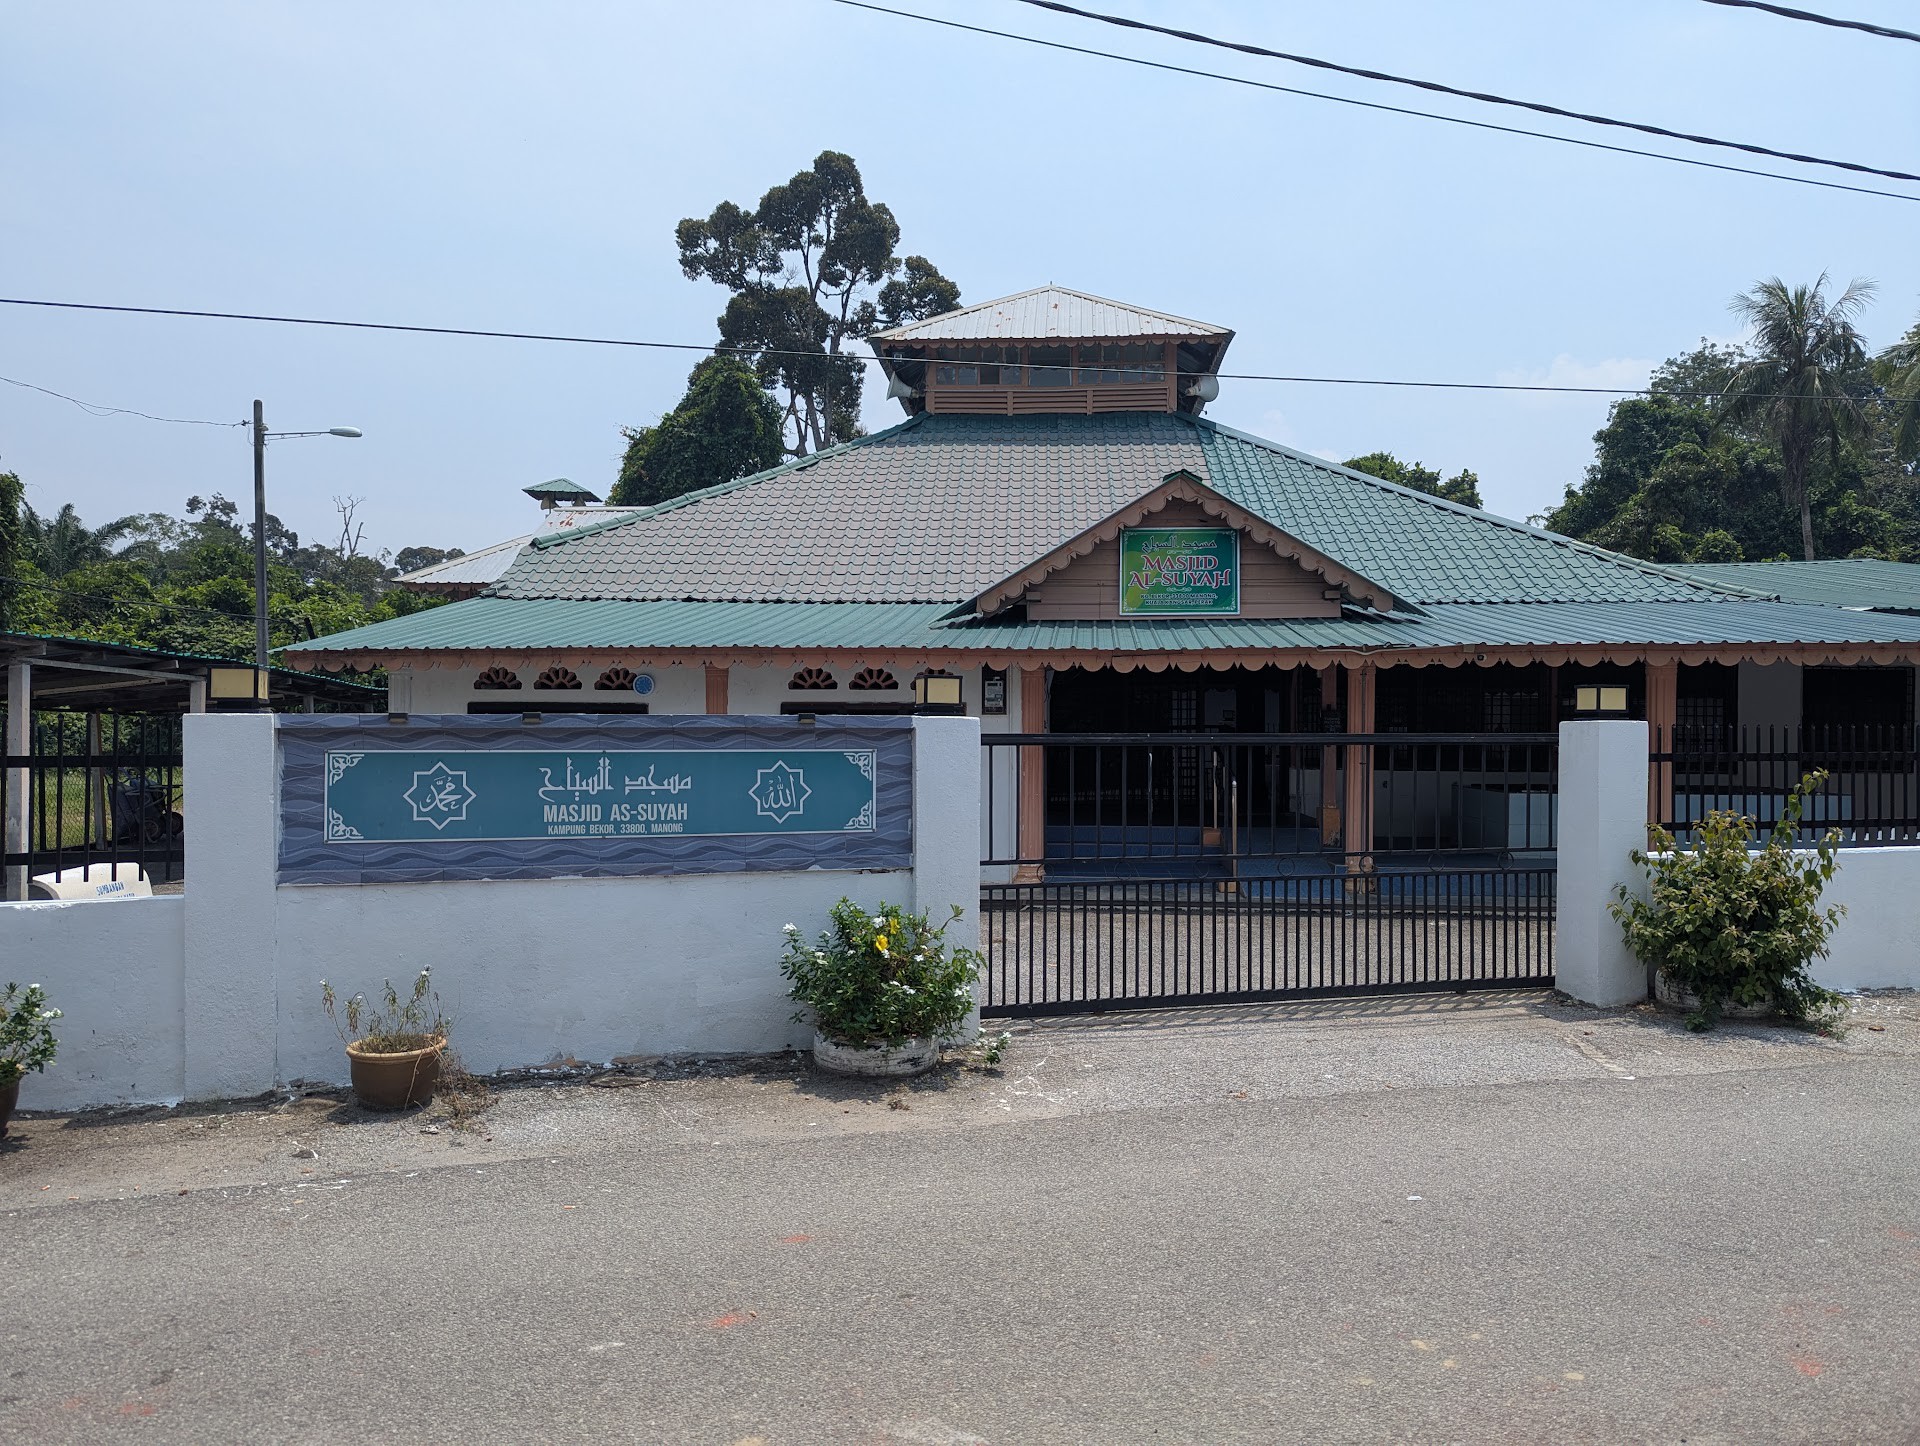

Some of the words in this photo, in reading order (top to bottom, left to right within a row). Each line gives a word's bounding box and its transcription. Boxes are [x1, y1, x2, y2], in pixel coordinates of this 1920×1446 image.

[1182, 539, 1217, 550] مسجد
[1142, 555, 1218, 572] MASJID
[1129, 569, 1231, 589] AL-SUYAH
[538, 756, 615, 803] السياح
[624, 763, 692, 796] مسجد
[543, 804, 602, 823] MASJID
[610, 802, 689, 822] AS-SUYAH
[547, 824, 586, 835] KAMPUNG
[589, 824, 617, 835] BEKOR,
[620, 823, 648, 835] 33800,
[651, 823, 684, 834] MANONG
